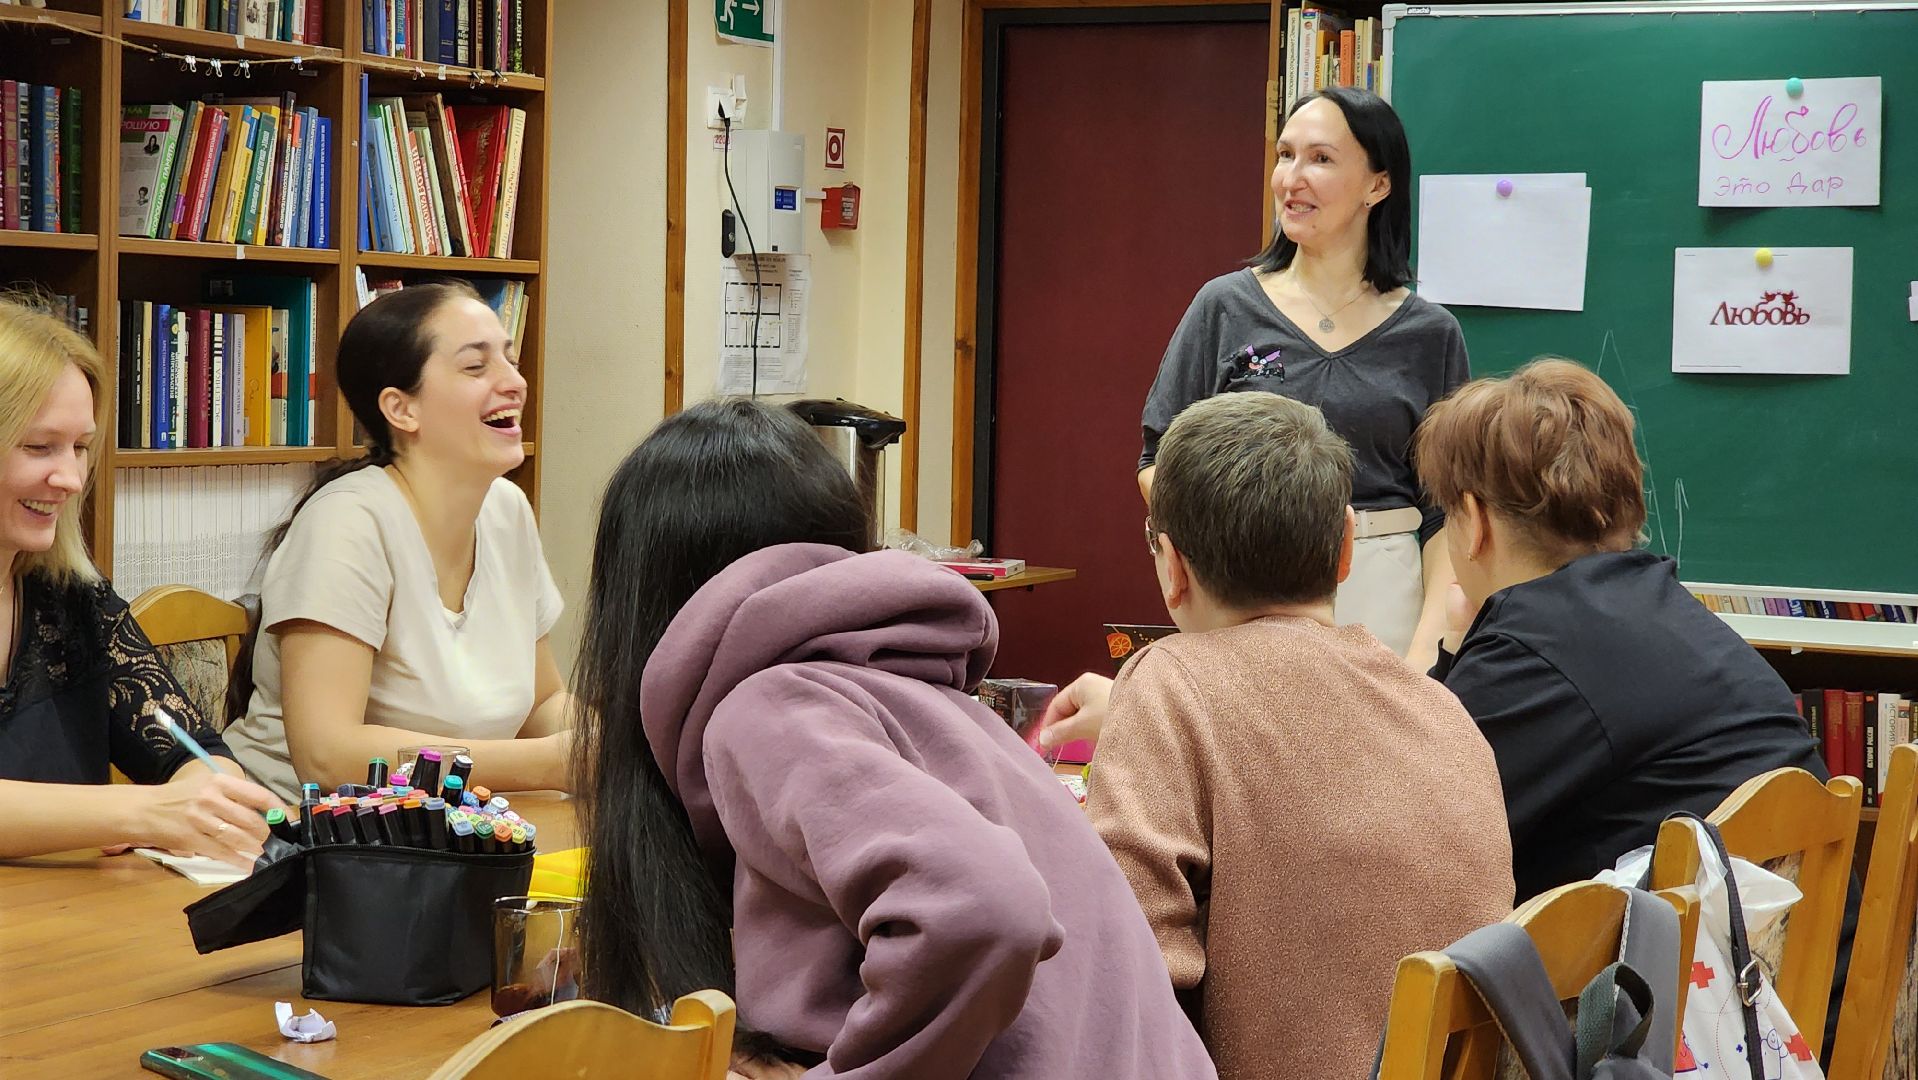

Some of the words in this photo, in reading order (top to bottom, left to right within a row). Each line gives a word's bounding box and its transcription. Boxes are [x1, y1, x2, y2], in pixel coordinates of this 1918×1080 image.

[1711, 95, 1868, 162] Любовь
[152, 182, 166, 233] ХОРОШУЮ
[161, 142, 175, 180] ПАМЯТЬ
[1888, 702, 1896, 741] ИСТОРИЯ
